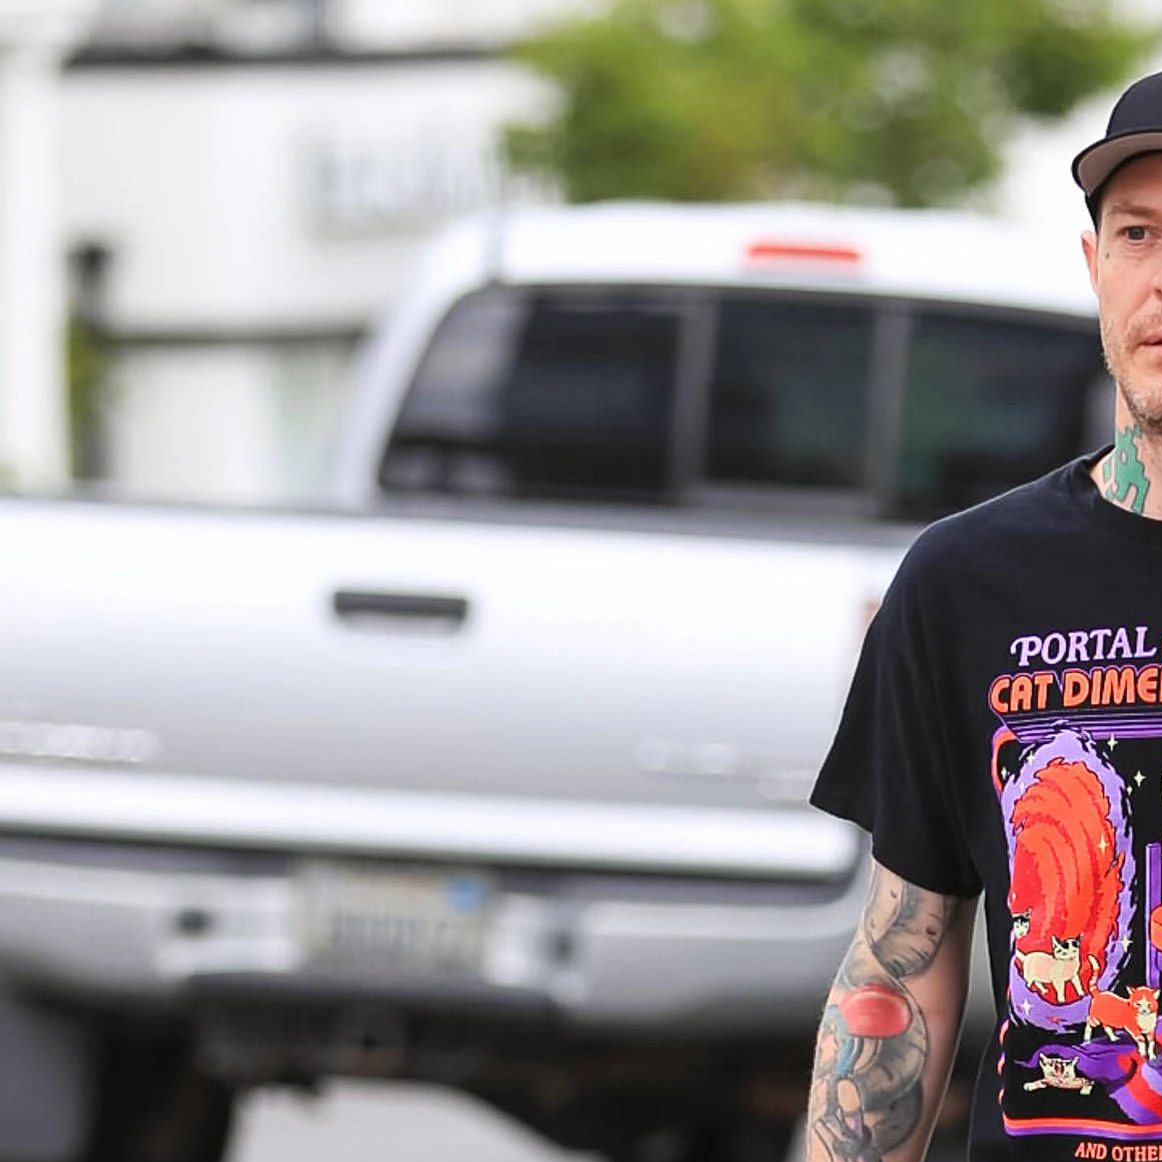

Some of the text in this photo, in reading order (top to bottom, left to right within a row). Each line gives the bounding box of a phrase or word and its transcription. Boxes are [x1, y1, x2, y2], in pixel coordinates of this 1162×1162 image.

[1010, 626, 1157, 666] PORTAL
[990, 673, 1053, 713] CAT
[1075, 1142, 1107, 1160] AND
